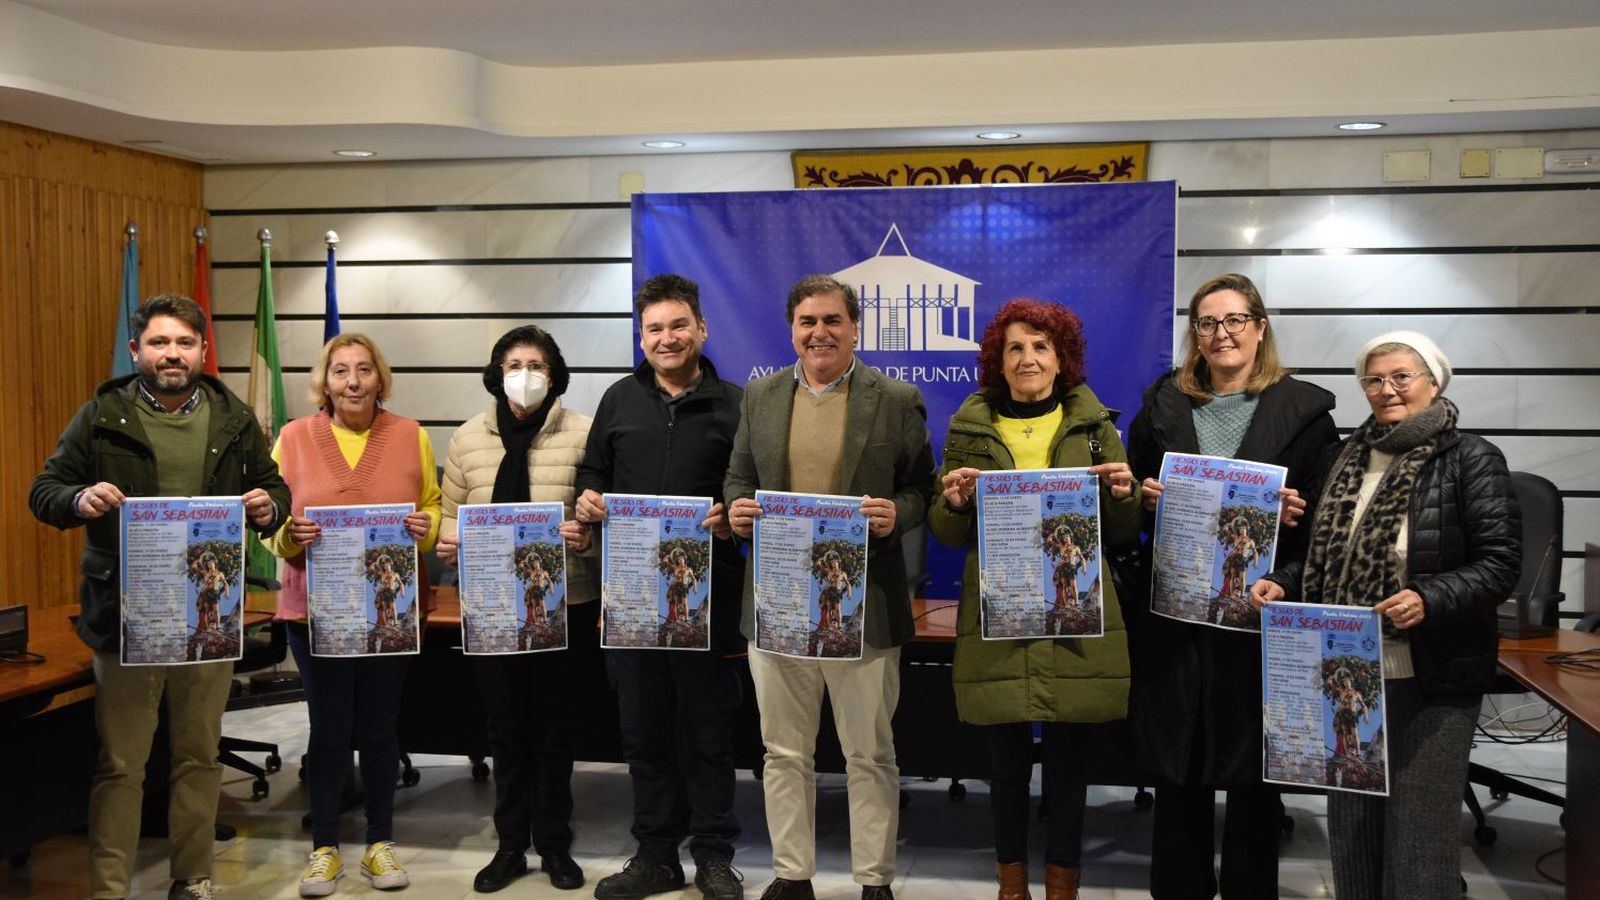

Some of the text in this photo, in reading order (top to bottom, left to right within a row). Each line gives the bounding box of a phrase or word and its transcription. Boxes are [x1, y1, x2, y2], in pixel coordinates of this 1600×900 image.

[886, 366, 909, 382] DE
[912, 366, 971, 383] PUNTA
[1171, 456, 1199, 465] FIESTAS
[1170, 464, 1270, 485] SAN SEBASTIÁN
[986, 478, 1083, 494] SAN SEBASTIÁN
[131, 507, 230, 521] SAN SEBASTIÁN
[465, 511, 551, 526] SAN SEBASTIÁN
[611, 506, 699, 519] SAN SEBASTIÁN
[763, 503, 854, 519] SAN SEBASTIÁN
[315, 513, 402, 528] SAN SEBASTIÁN
[1269, 615, 1363, 632] SAN SEBASTIÁN
